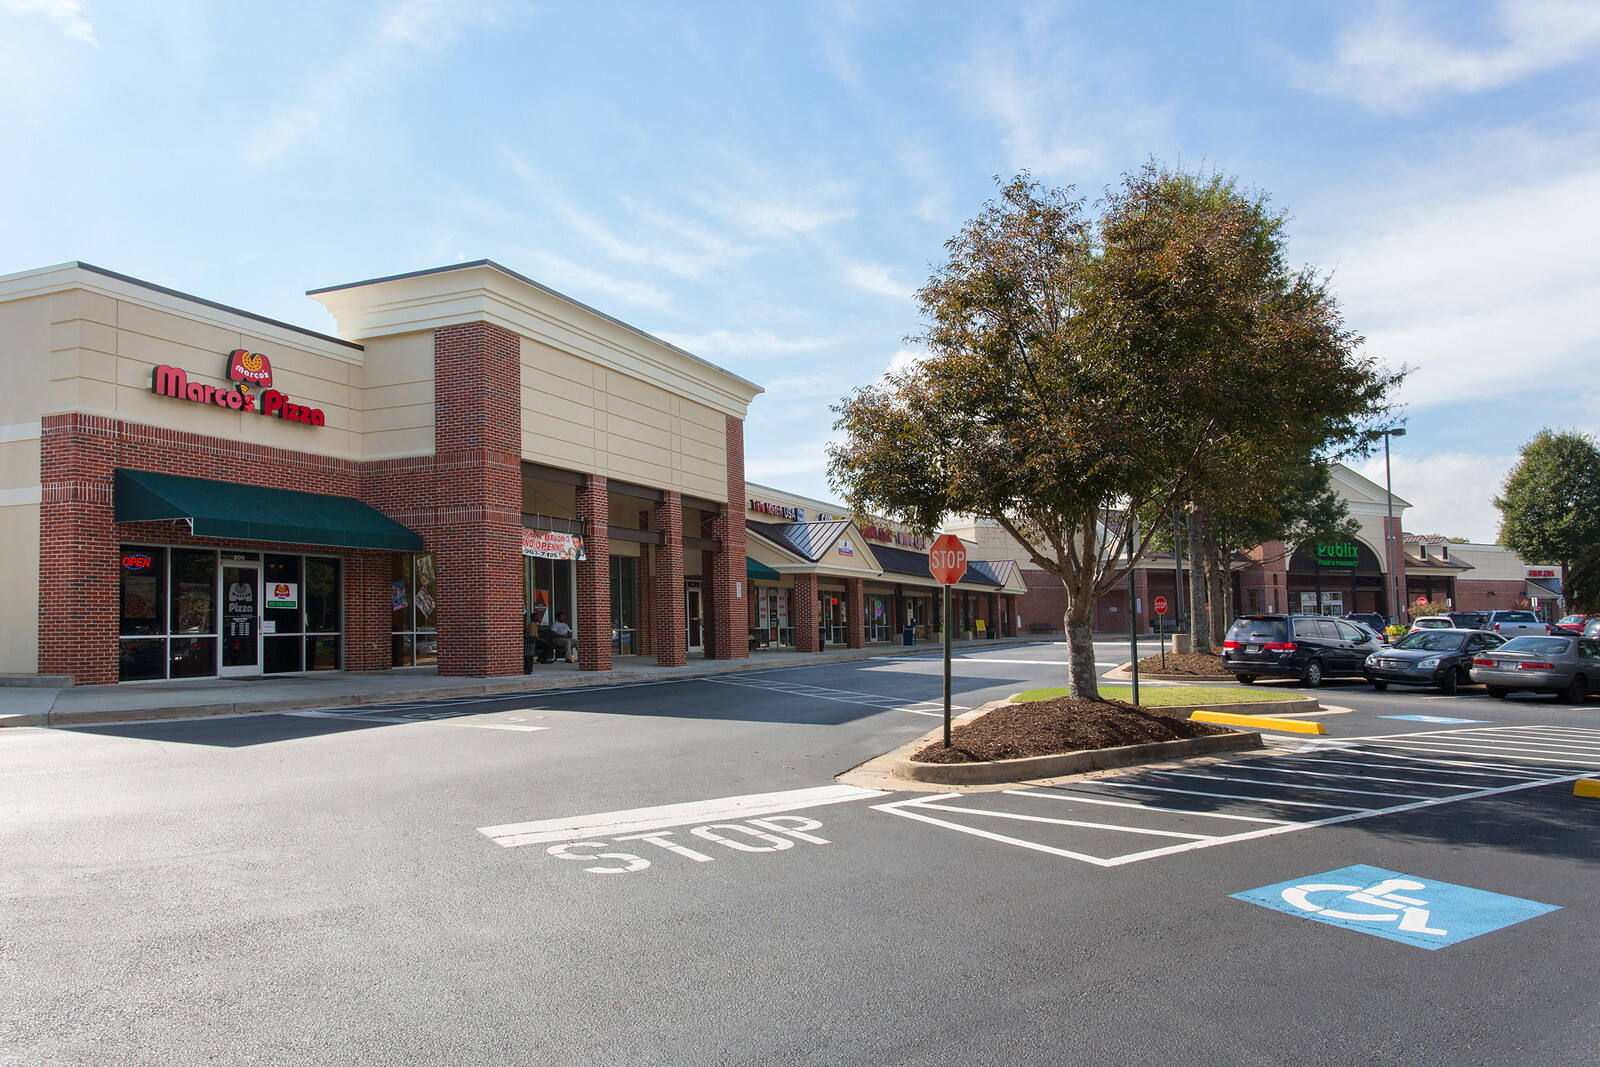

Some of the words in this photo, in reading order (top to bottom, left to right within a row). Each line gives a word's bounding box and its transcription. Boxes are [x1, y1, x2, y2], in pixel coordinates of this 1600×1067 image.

[152, 364, 255, 412] Marco's
[260, 389, 325, 427] Pizza
[1317, 541, 1358, 557] Publix
[122, 556, 151, 567] OPEN
[931, 550, 965, 569] STOP
[229, 603, 253, 613] Pizza
[546, 815, 832, 874] STOP
